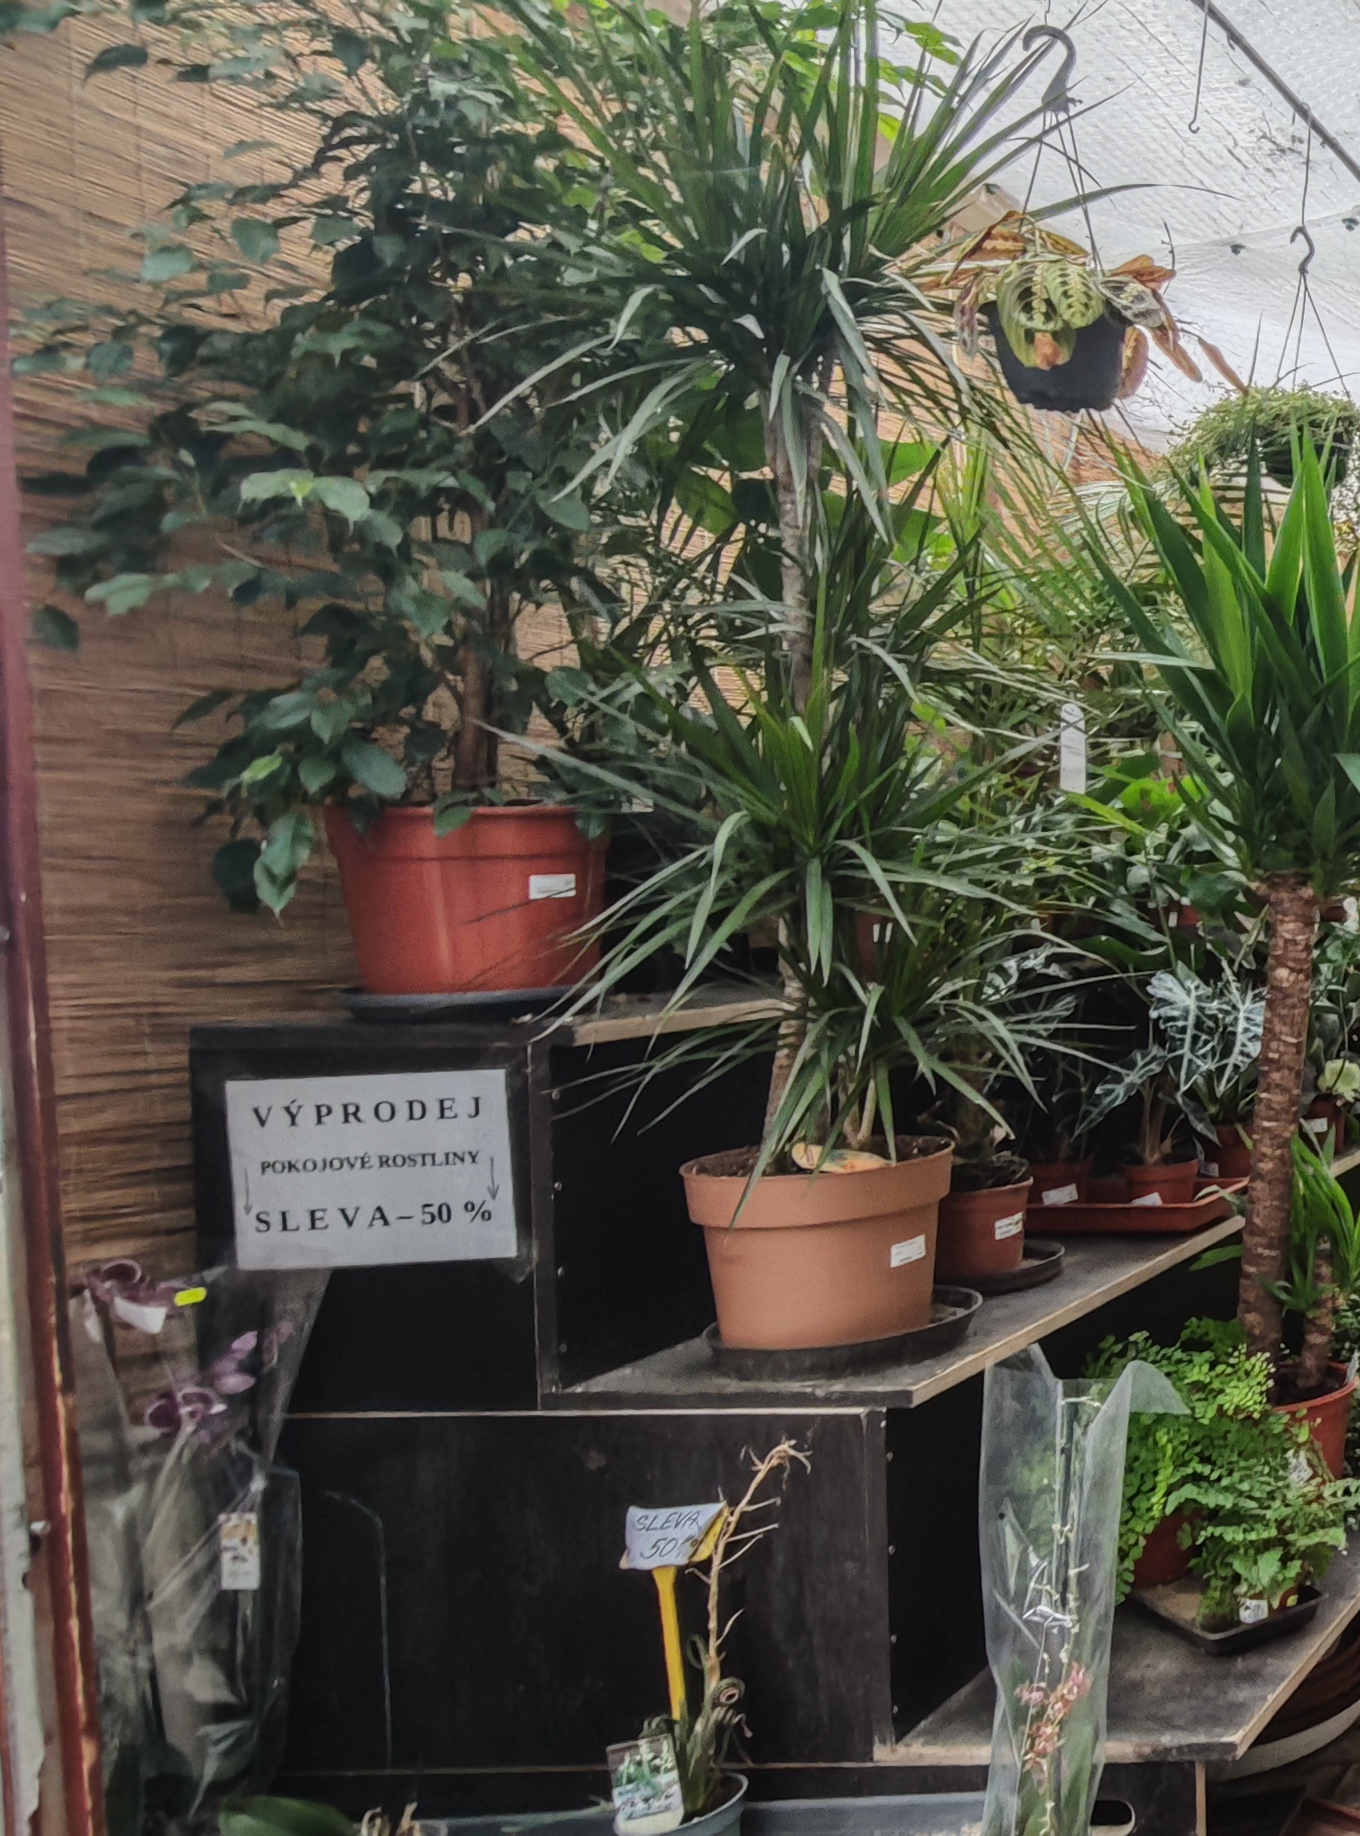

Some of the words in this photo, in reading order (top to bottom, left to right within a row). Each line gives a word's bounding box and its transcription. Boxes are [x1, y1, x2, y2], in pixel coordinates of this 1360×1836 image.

[252, 1096, 482, 1128] VÝPRODEJ
[260, 1152, 373, 1176] POKOJOVÉ
[377, 1150, 481, 1169] ROSTLINY
[254, 1205, 391, 1233] SLEVA
[635, 1511, 701, 1533] SLEVA
